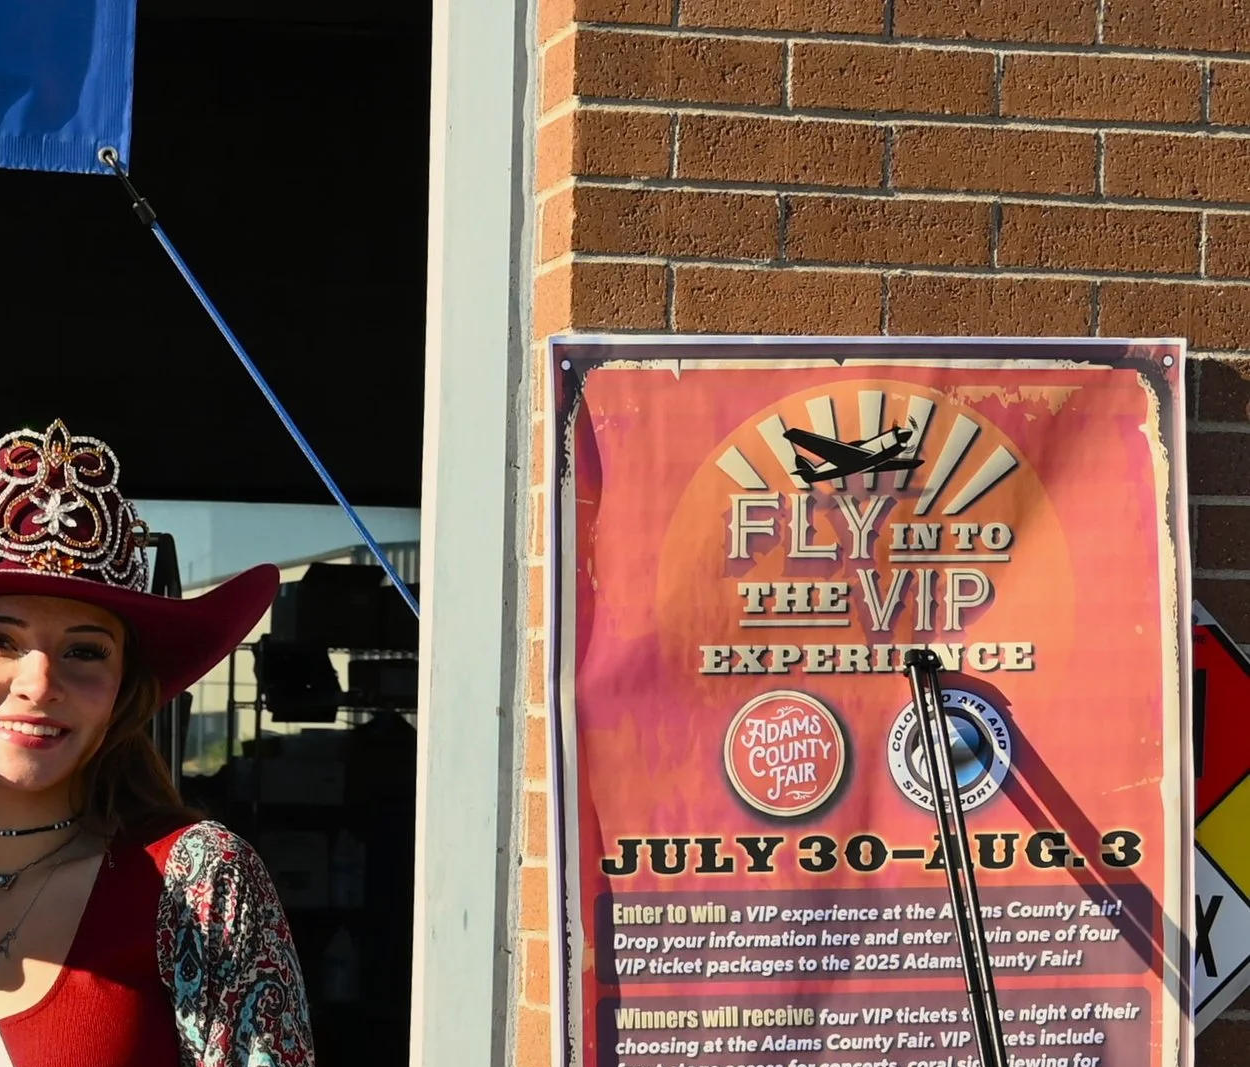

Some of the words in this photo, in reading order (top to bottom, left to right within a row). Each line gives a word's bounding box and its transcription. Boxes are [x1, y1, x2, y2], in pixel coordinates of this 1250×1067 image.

[728, 492, 894, 560] FLY
[890, 523, 941, 550] IN
[951, 522, 1012, 550] TO
[738, 582, 849, 613] THE
[856, 568, 990, 632] VIP
[741, 715, 821, 748] ADAMS
[958, 696, 986, 714] AIR
[987, 717, 1007, 751] AND
[749, 739, 832, 778] COUNTY
[767, 764, 817, 801] FAIR
[602, 836, 784, 876] JULY
[1102, 831, 1142, 868] 3
[613, 903, 663, 925] Enter
[667, 904, 686, 924] to
[691, 902, 726, 923] win
[730, 911, 741, 923] a
[746, 906, 777, 921] VIP
[781, 904, 878, 925] experience
[882, 904, 901, 920] at
[906, 903, 935, 920] the
[1007, 901, 1075, 921] County
[1079, 900, 1122, 917] Fair!
[613, 933, 658, 952] Drop
[662, 935, 705, 953] your
[708, 931, 816, 949] information
[821, 929, 860, 947] here
[865, 928, 898, 945] and
[902, 930, 951, 945] enter
[1016, 929, 1049, 943] one
[1055, 926, 1075, 943] of
[1079, 924, 1120, 943] four
[615, 958, 646, 975] VIP
[649, 957, 702, 974] ticket
[706, 956, 794, 977] packages
[799, 956, 817, 972] to
[821, 955, 850, 971] the
[854, 953, 899, 971] 2025
[903, 953, 963, 970] Adams
[1040, 950, 1083, 967] Fair!
[615, 1008, 698, 1029] Winners
[702, 1006, 738, 1028] will
[742, 1005, 814, 1027] receive
[819, 1009, 858, 1026] four
[862, 1007, 893, 1024] VIP
[896, 1007, 957, 1024] tickets
[1019, 1004, 1067, 1025] night
[1071, 1004, 1091, 1020] of
[1094, 1002, 1140, 1020] their
[615, 1037, 699, 1057] choosing
[703, 1037, 722, 1053] at
[727, 1036, 758, 1052] the
[761, 1035, 822, 1051] Adams
[826, 1033, 893, 1053] County
[897, 1033, 935, 1048] Fair.
[940, 1031, 971, 1047] VIP
[1040, 1028, 1105, 1046] include
